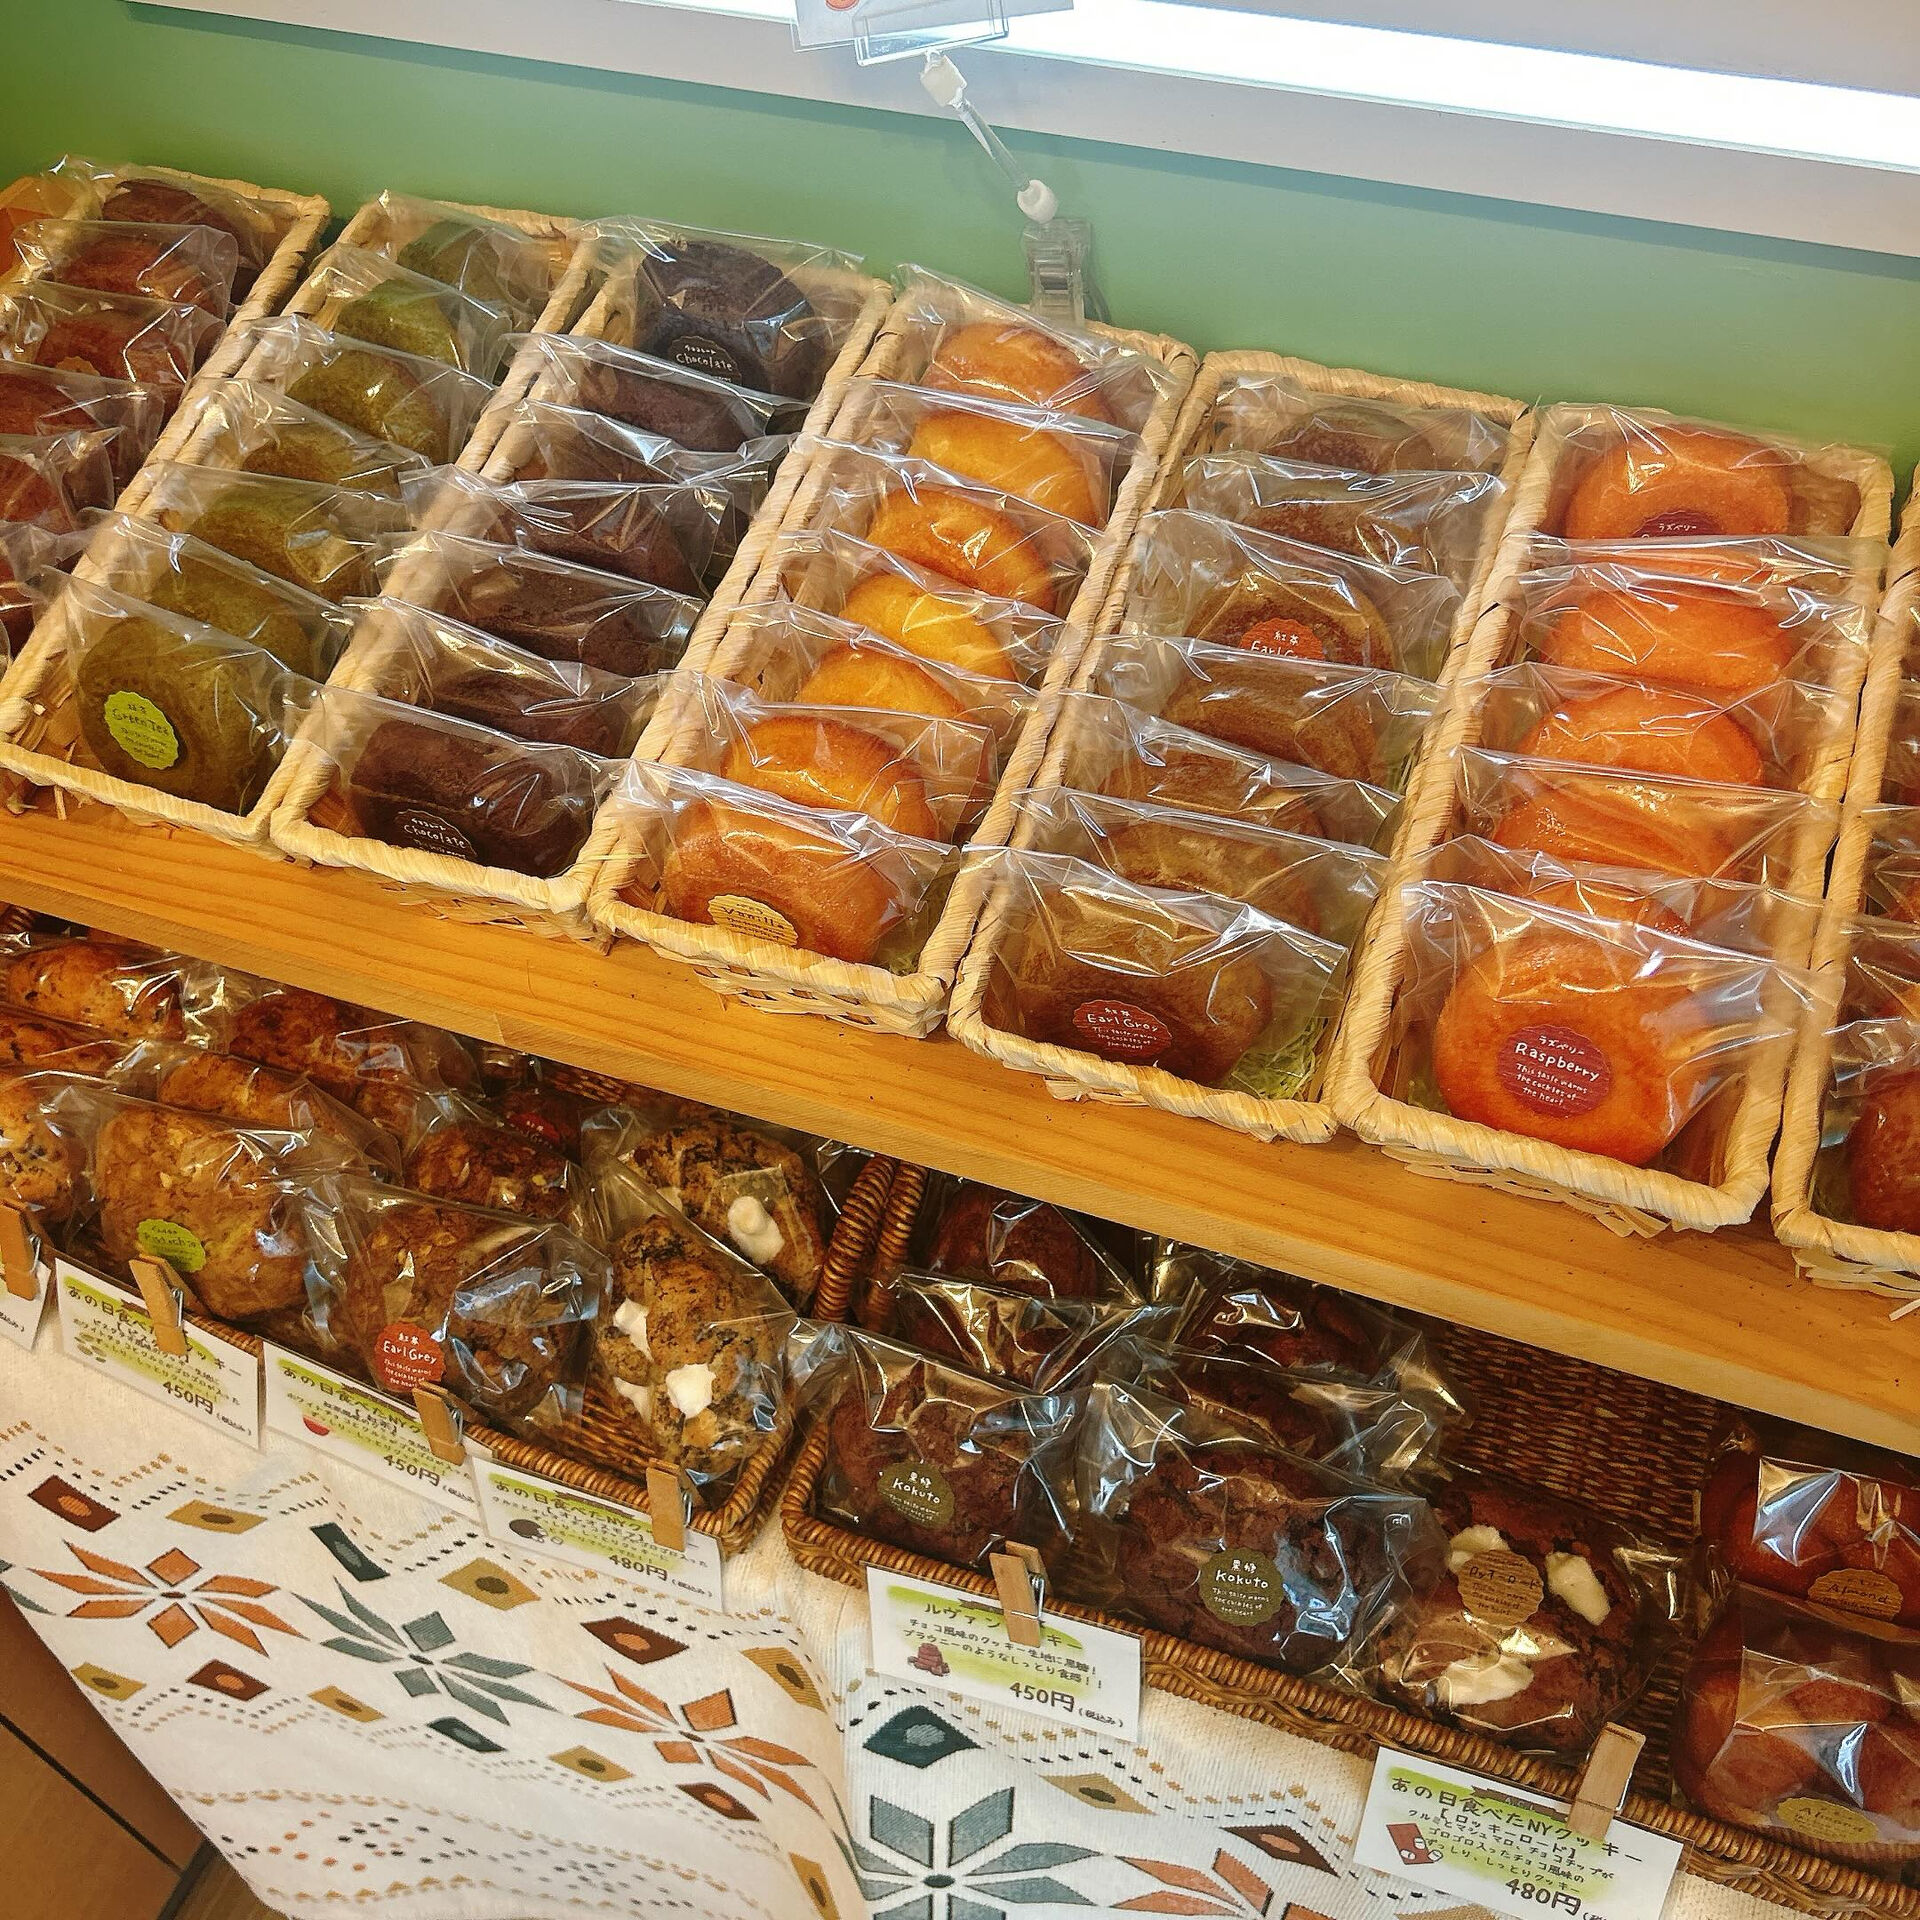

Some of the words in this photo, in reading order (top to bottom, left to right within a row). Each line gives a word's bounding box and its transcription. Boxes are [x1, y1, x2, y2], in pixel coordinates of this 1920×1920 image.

[675, 352, 733, 372] Chocolate
[1273, 630, 1299, 646] 紅茶
[403, 824, 466, 849] Chocolate
[720, 906, 785, 930] Vanilla
[1086, 1013, 1120, 1025] Earl
[1539, 1035, 1585, 1055] ラズベリー
[1514, 1042, 1600, 1082] Raspberry
[1516, 1063, 1535, 1075] This
[1537, 1070, 1559, 1084] taste
[1560, 1080, 1588, 1094] warms
[1516, 1073, 1531, 1084] the
[1566, 1092, 1577, 1101] of
[1522, 1086, 1537, 1097] the
[1539, 1092, 1564, 1106] heart
[67, 1285, 242, 1377] あの日食べッキー
[383, 1340, 407, 1357] Earl
[408, 1348, 437, 1364] Grey
[163, 1380, 214, 1416] 450円
[282, 1366, 422, 1435] あの日食べたNYク
[383, 1454, 441, 1487] 450円
[892, 1477, 941, 1504] Kokuto
[495, 1481, 700, 1548] あの日食べたNYクー
[608, 1554, 668, 1582] 480円
[1215, 1569, 1269, 1589] Kokuto
[1828, 1583, 1890, 1603] Almond
[923, 1602, 1084, 1651] ルヴァンキー
[1009, 1681, 1075, 1713] 450円
[1078, 1707, 1125, 1728] (税込み)
[1391, 1776, 1643, 1864] あの日食べたNYクッキー
[1439, 1807, 1577, 1860] 【ロッキーロード】
[1428, 1826, 1585, 1884] ゴロゴロ入ったチョコ風味の
[1504, 1877, 1582, 1917] 480円
